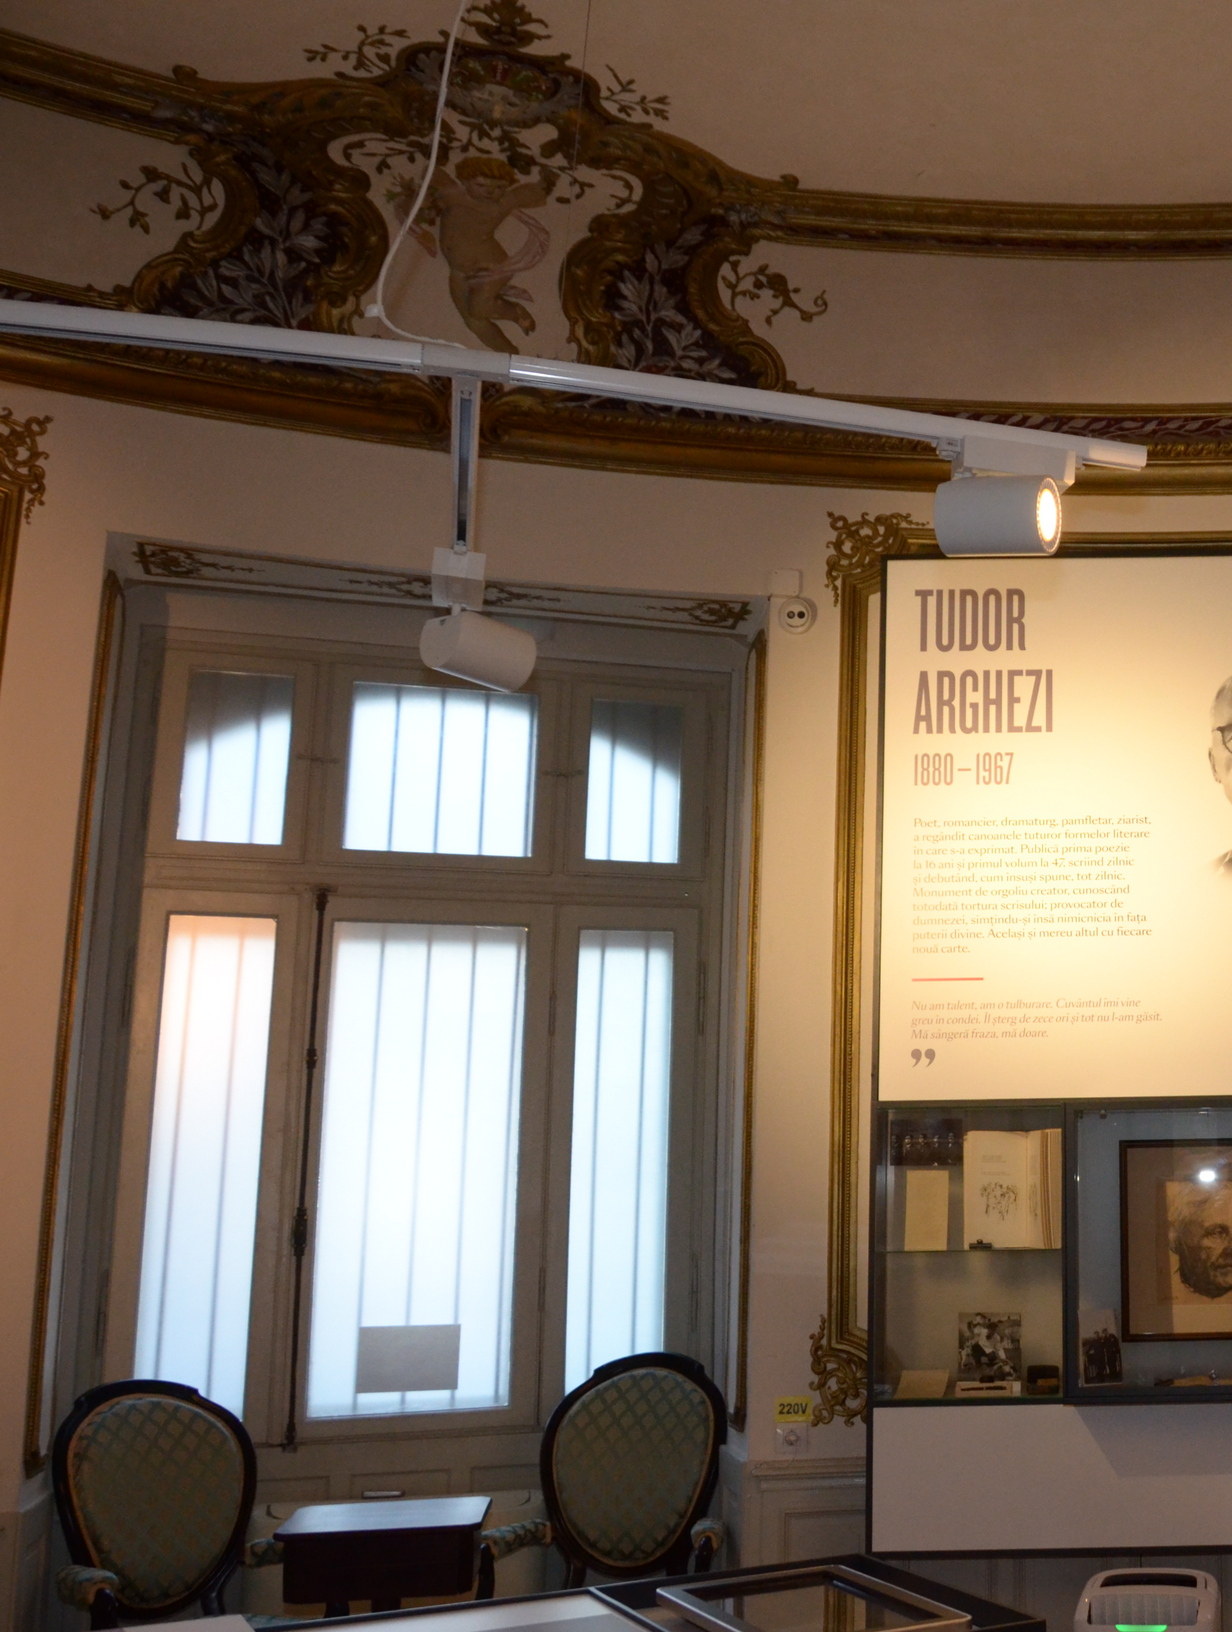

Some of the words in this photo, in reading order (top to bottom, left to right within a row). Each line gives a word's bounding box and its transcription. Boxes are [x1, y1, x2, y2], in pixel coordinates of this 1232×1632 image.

[914, 588, 1026, 652] TUDOR
[912, 669, 1053, 734] ARGHEZI
[968, 831, 1022, 841] canoanele
[1025, 832, 1062, 840] tuturor
[1065, 830, 1110, 840] formelor
[1114, 829, 1150, 839] literare
[926, 848, 948, 856] care
[1062, 844, 1092, 856] prima
[1095, 843, 1130, 855] poezie
[914, 860, 922, 870] la
[926, 860, 936, 870] 16
[938, 860, 954, 870] ani
[968, 859, 1002, 871] primul
[1005, 859, 1038, 869] volum
[1041, 858, 1049, 868] la
[1069, 858, 1104, 868] scriind
[1107, 857, 1134, 867] zilnic
[980, 875, 1004, 883] cum
[1077, 873, 1092, 881] tot
[914, 887, 972, 897] Monument
[976, 886, 988, 896] de
[991, 886, 1028, 898] orgoliu
[962, 902, 998, 911] tortura
[1050, 901, 1108, 911] provocator
[1110, 899, 1124, 909] de
[1058, 914, 1112, 923] nimicnicia
[912, 929, 947, 941] puterii
[1076, 927, 1099, 937] altul
[1101, 929, 1114, 937] cu
[1117, 926, 1152, 936] fiecare
[912, 1001, 927, 1010] Nu
[980, 1002, 996, 1010] am
[1121, 998, 1141, 1008] vine
[912, 1018, 933, 1027] greu
[1019, 1014, 1031, 1023] de
[1056, 1013, 1070, 1023] ori
[1081, 1014, 1095, 1023] tot
[1112, 1012, 1134, 1022] l-am
[779, 1402, 808, 1415] 220V
